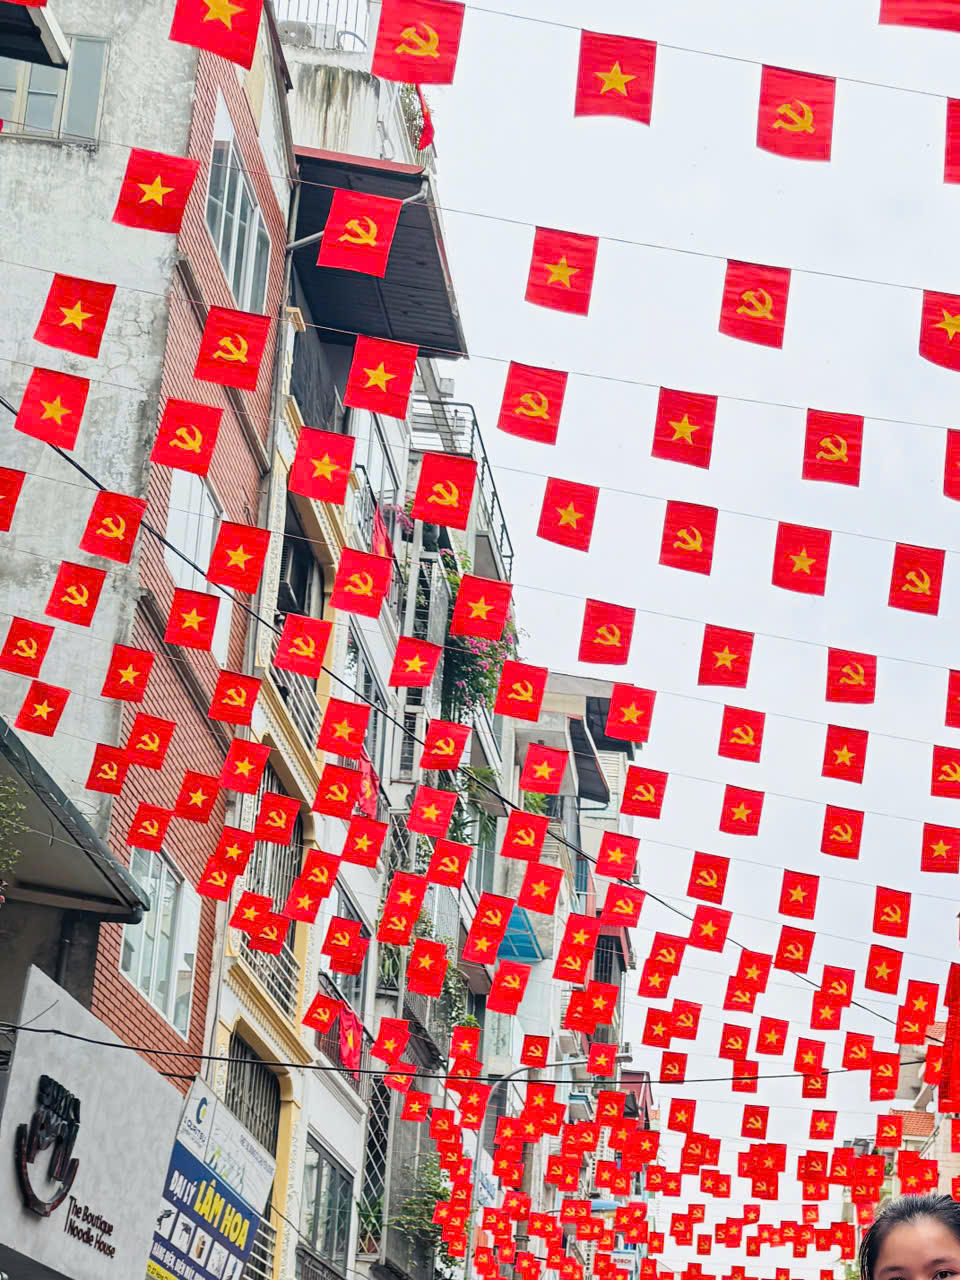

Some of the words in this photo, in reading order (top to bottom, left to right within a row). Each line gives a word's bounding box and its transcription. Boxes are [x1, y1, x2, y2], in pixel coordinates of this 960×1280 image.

[64, 1195, 82, 1233] The
[82, 1205, 113, 1236] Boutique
[194, 1179, 225, 1228] LÂM
[219, 1203, 250, 1251] HOA
[67, 1219, 94, 1246] Noodle
[94, 1233, 116, 1258] House
